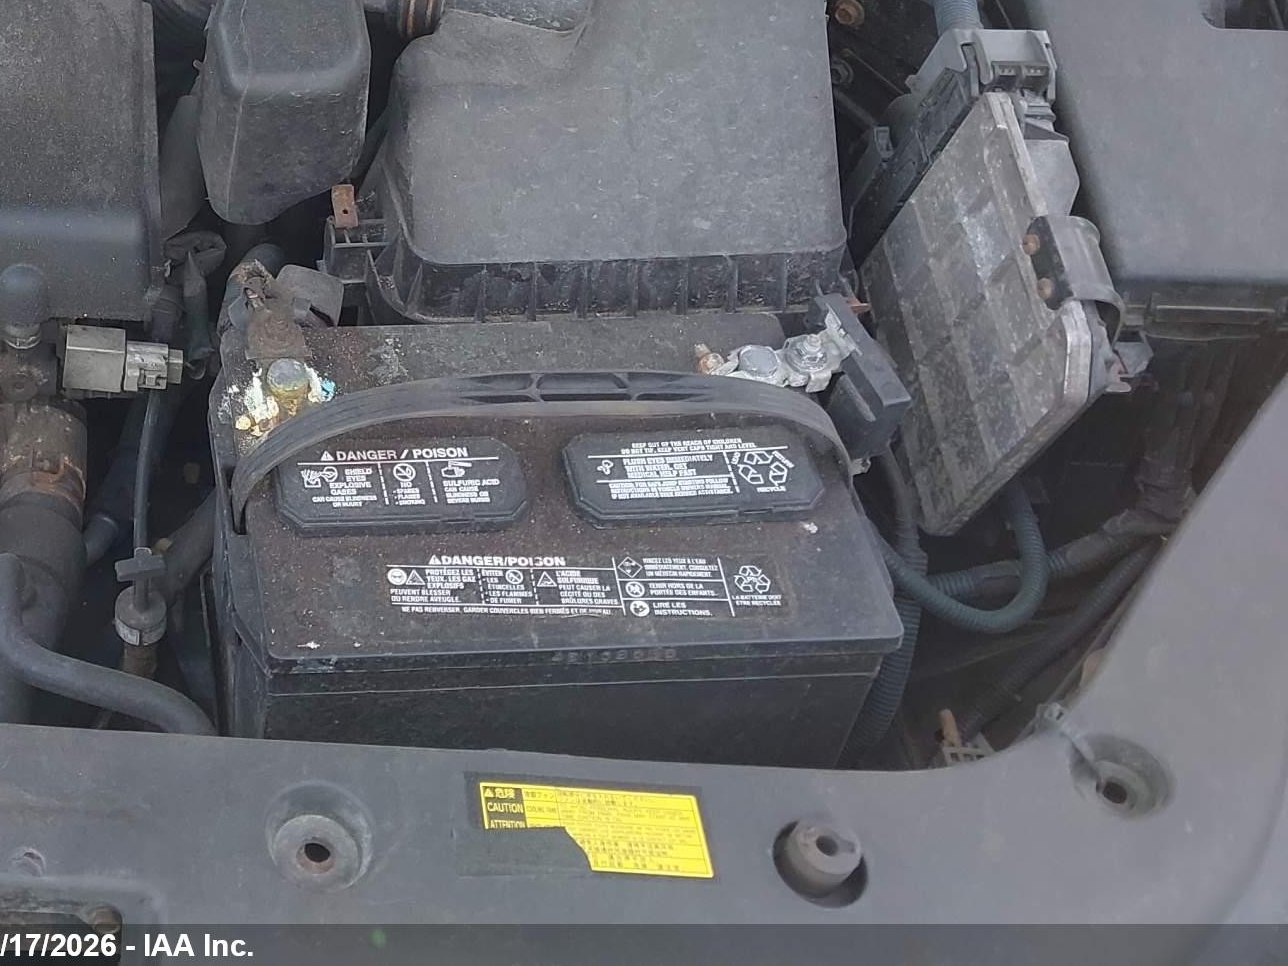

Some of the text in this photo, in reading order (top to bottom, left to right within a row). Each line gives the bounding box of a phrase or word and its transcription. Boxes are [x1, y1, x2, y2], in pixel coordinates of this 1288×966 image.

[336, 450, 397, 461] DANGER
[413, 447, 468, 459] POISON
[481, 478, 501, 486] ACID
[486, 802, 524, 814] CAUTION
